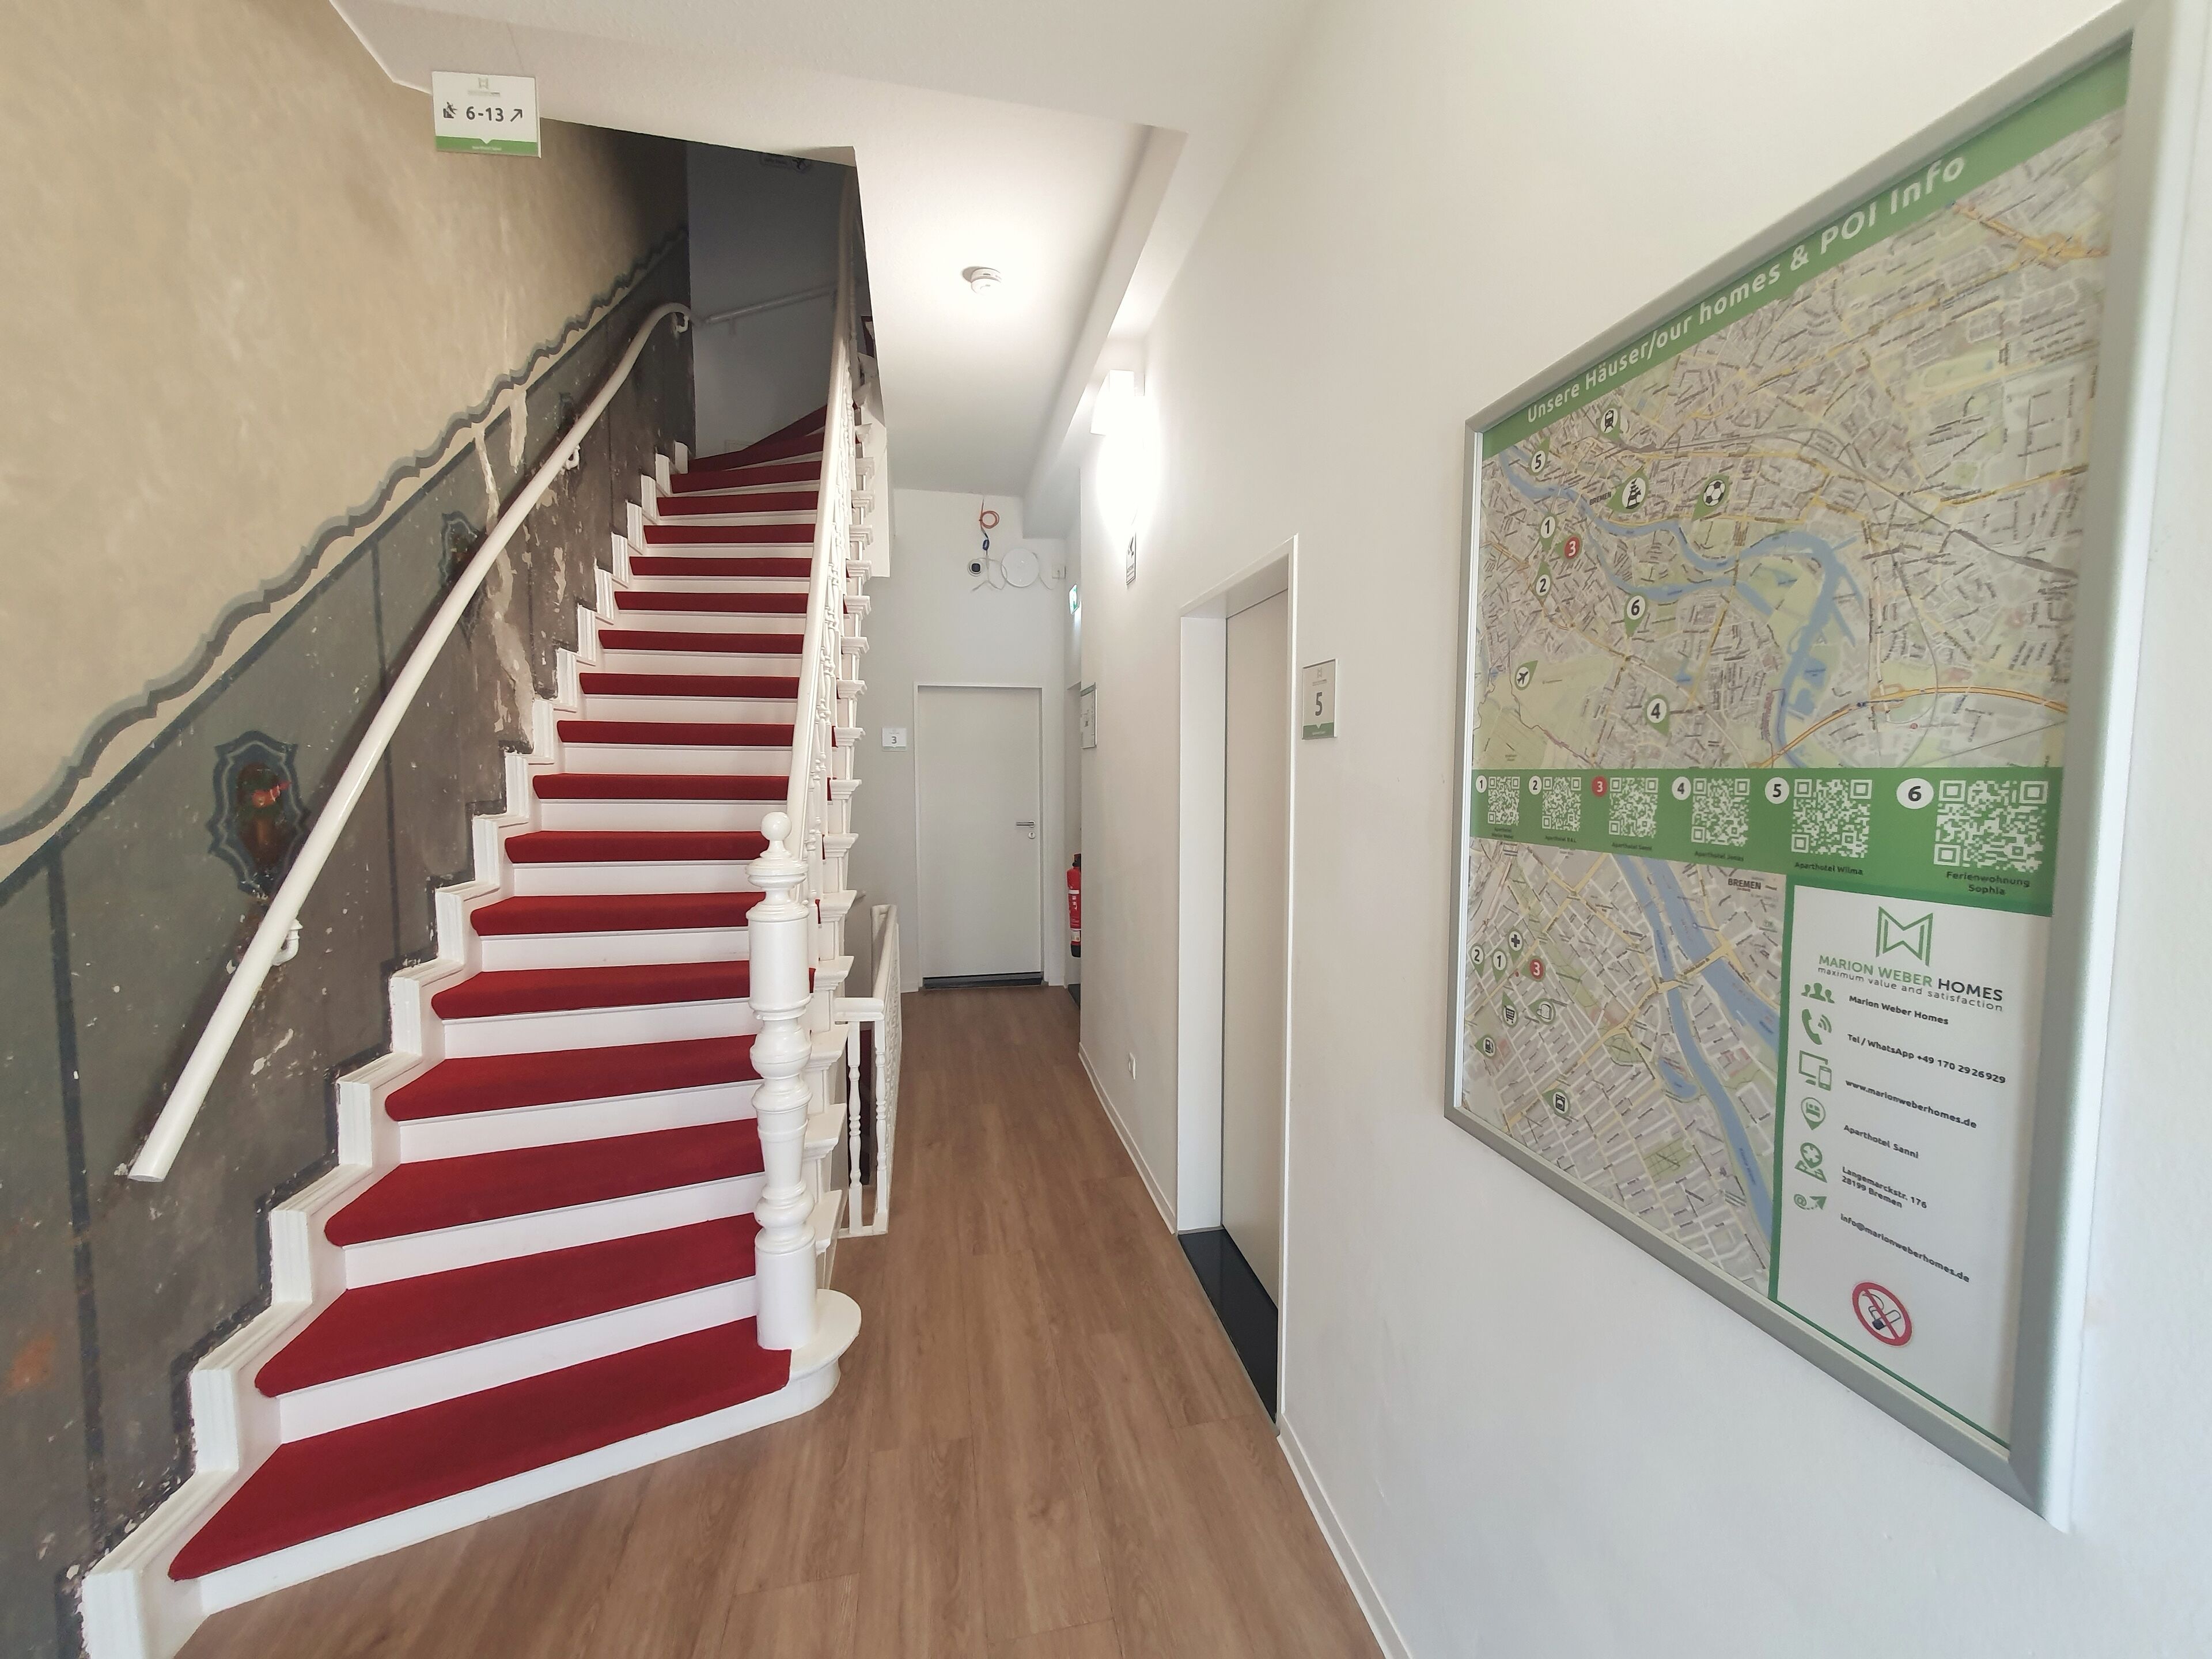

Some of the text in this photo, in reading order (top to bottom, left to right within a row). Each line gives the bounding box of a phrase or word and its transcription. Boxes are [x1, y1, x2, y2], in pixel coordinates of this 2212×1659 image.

[466, 106, 505, 122] 6-13
[1528, 157, 1965, 423] Unsere Häuser/our homes & POI Info
[1535, 454, 1543, 469] 5
[1544, 520, 1550, 535] 1
[1569, 540, 1576, 556] 3
[1539, 578, 1547, 593] 2
[1631, 599, 1640, 616] 6
[1315, 691, 1323, 717] 5
[1650, 703, 1661, 719] 4
[891, 736, 897, 744] 3
[1479, 779, 1484, 789] 1
[1532, 779, 1539, 790] 2
[1596, 781, 1604, 793] 3
[1676, 782, 1686, 794] 4
[1772, 783, 1782, 798] 5
[1907, 785, 1922, 802] 6
[1794, 862, 1863, 876] Aparthotel Wilma
[1728, 878, 1762, 890] BREMEN
[1946, 870, 2031, 888] Ferienwohnung
[1968, 884, 2005, 896] Sophia
[1474, 949, 1480, 963] 2
[1497, 955, 1502, 967] 1
[1533, 961, 1540, 976] 3
[1819, 955, 2003, 1002] MARION WEBER HOMES
[1817, 967, 2003, 1013] maximum value and satisfaction
[1849, 995, 1949, 1025] Marion Weber Homes
[1847, 1033, 1860, 1044] Tel
[1867, 1039, 1915, 1060] WhatsApp
[1916, 1055, 1935, 1065] +49
[1937, 1059, 1956, 1070] 170
[1845, 1080, 1977, 1129] www.marionweberhomes.de
[1843, 1124, 1919, 1159] Aparthotel Sanni
[1841, 1175, 1903, 1209] 28199 Bremen
[1842, 1166, 1927, 1209] Langemarckstr. 176
[1840, 1213, 1970, 1283] info@marionweberhomes.de
